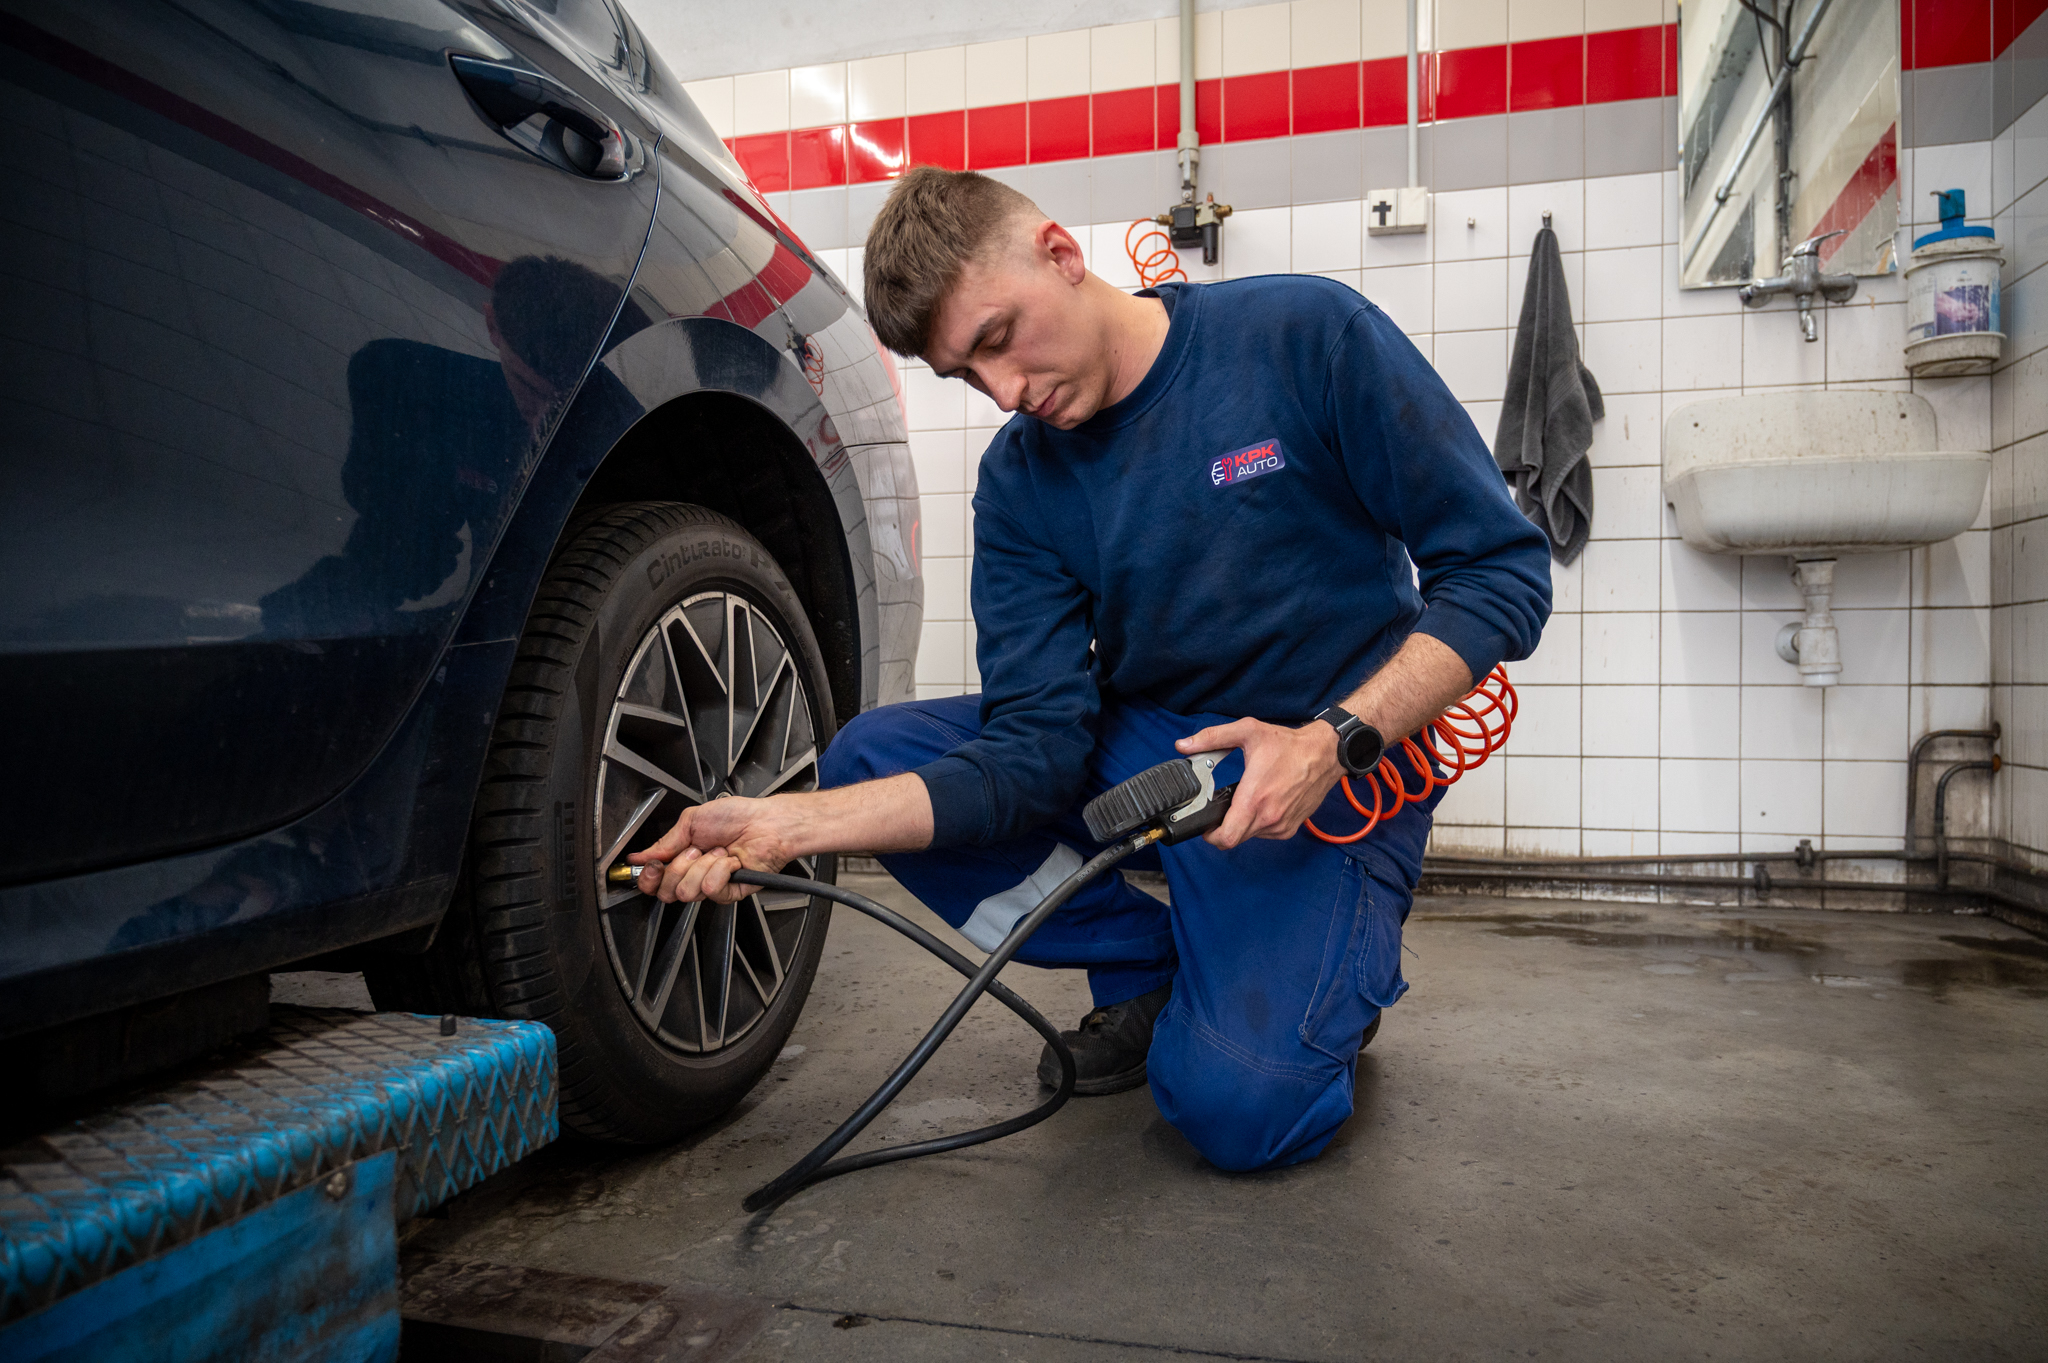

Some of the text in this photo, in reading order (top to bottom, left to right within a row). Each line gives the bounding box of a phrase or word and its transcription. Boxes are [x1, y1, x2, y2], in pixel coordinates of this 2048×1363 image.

[1234, 443, 1276, 467] KPK
[1237, 456, 1278, 478] AUTO
[646, 538, 742, 591] Cinturato
